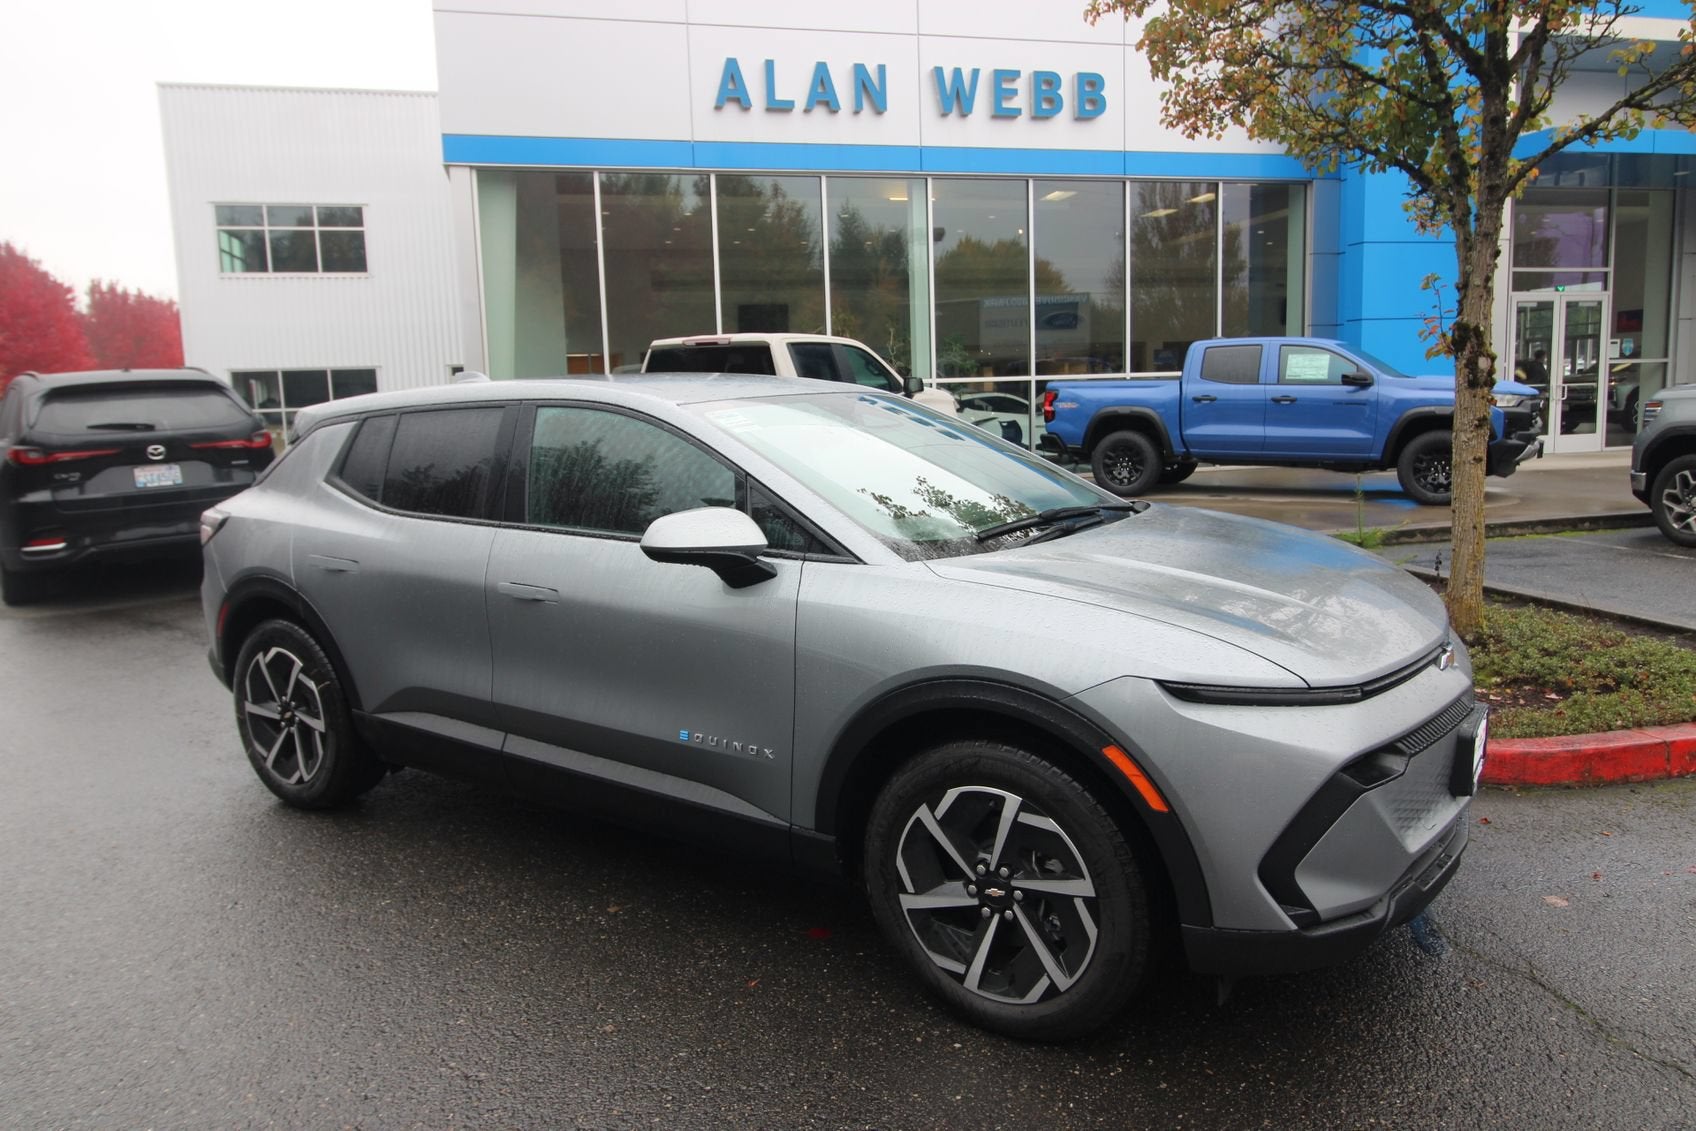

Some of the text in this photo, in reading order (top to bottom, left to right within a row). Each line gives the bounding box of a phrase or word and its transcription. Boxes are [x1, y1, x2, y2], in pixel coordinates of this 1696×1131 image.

[714, 57, 1108, 121] ALAN WEBB
[679, 730, 776, 760] EQUINOX
